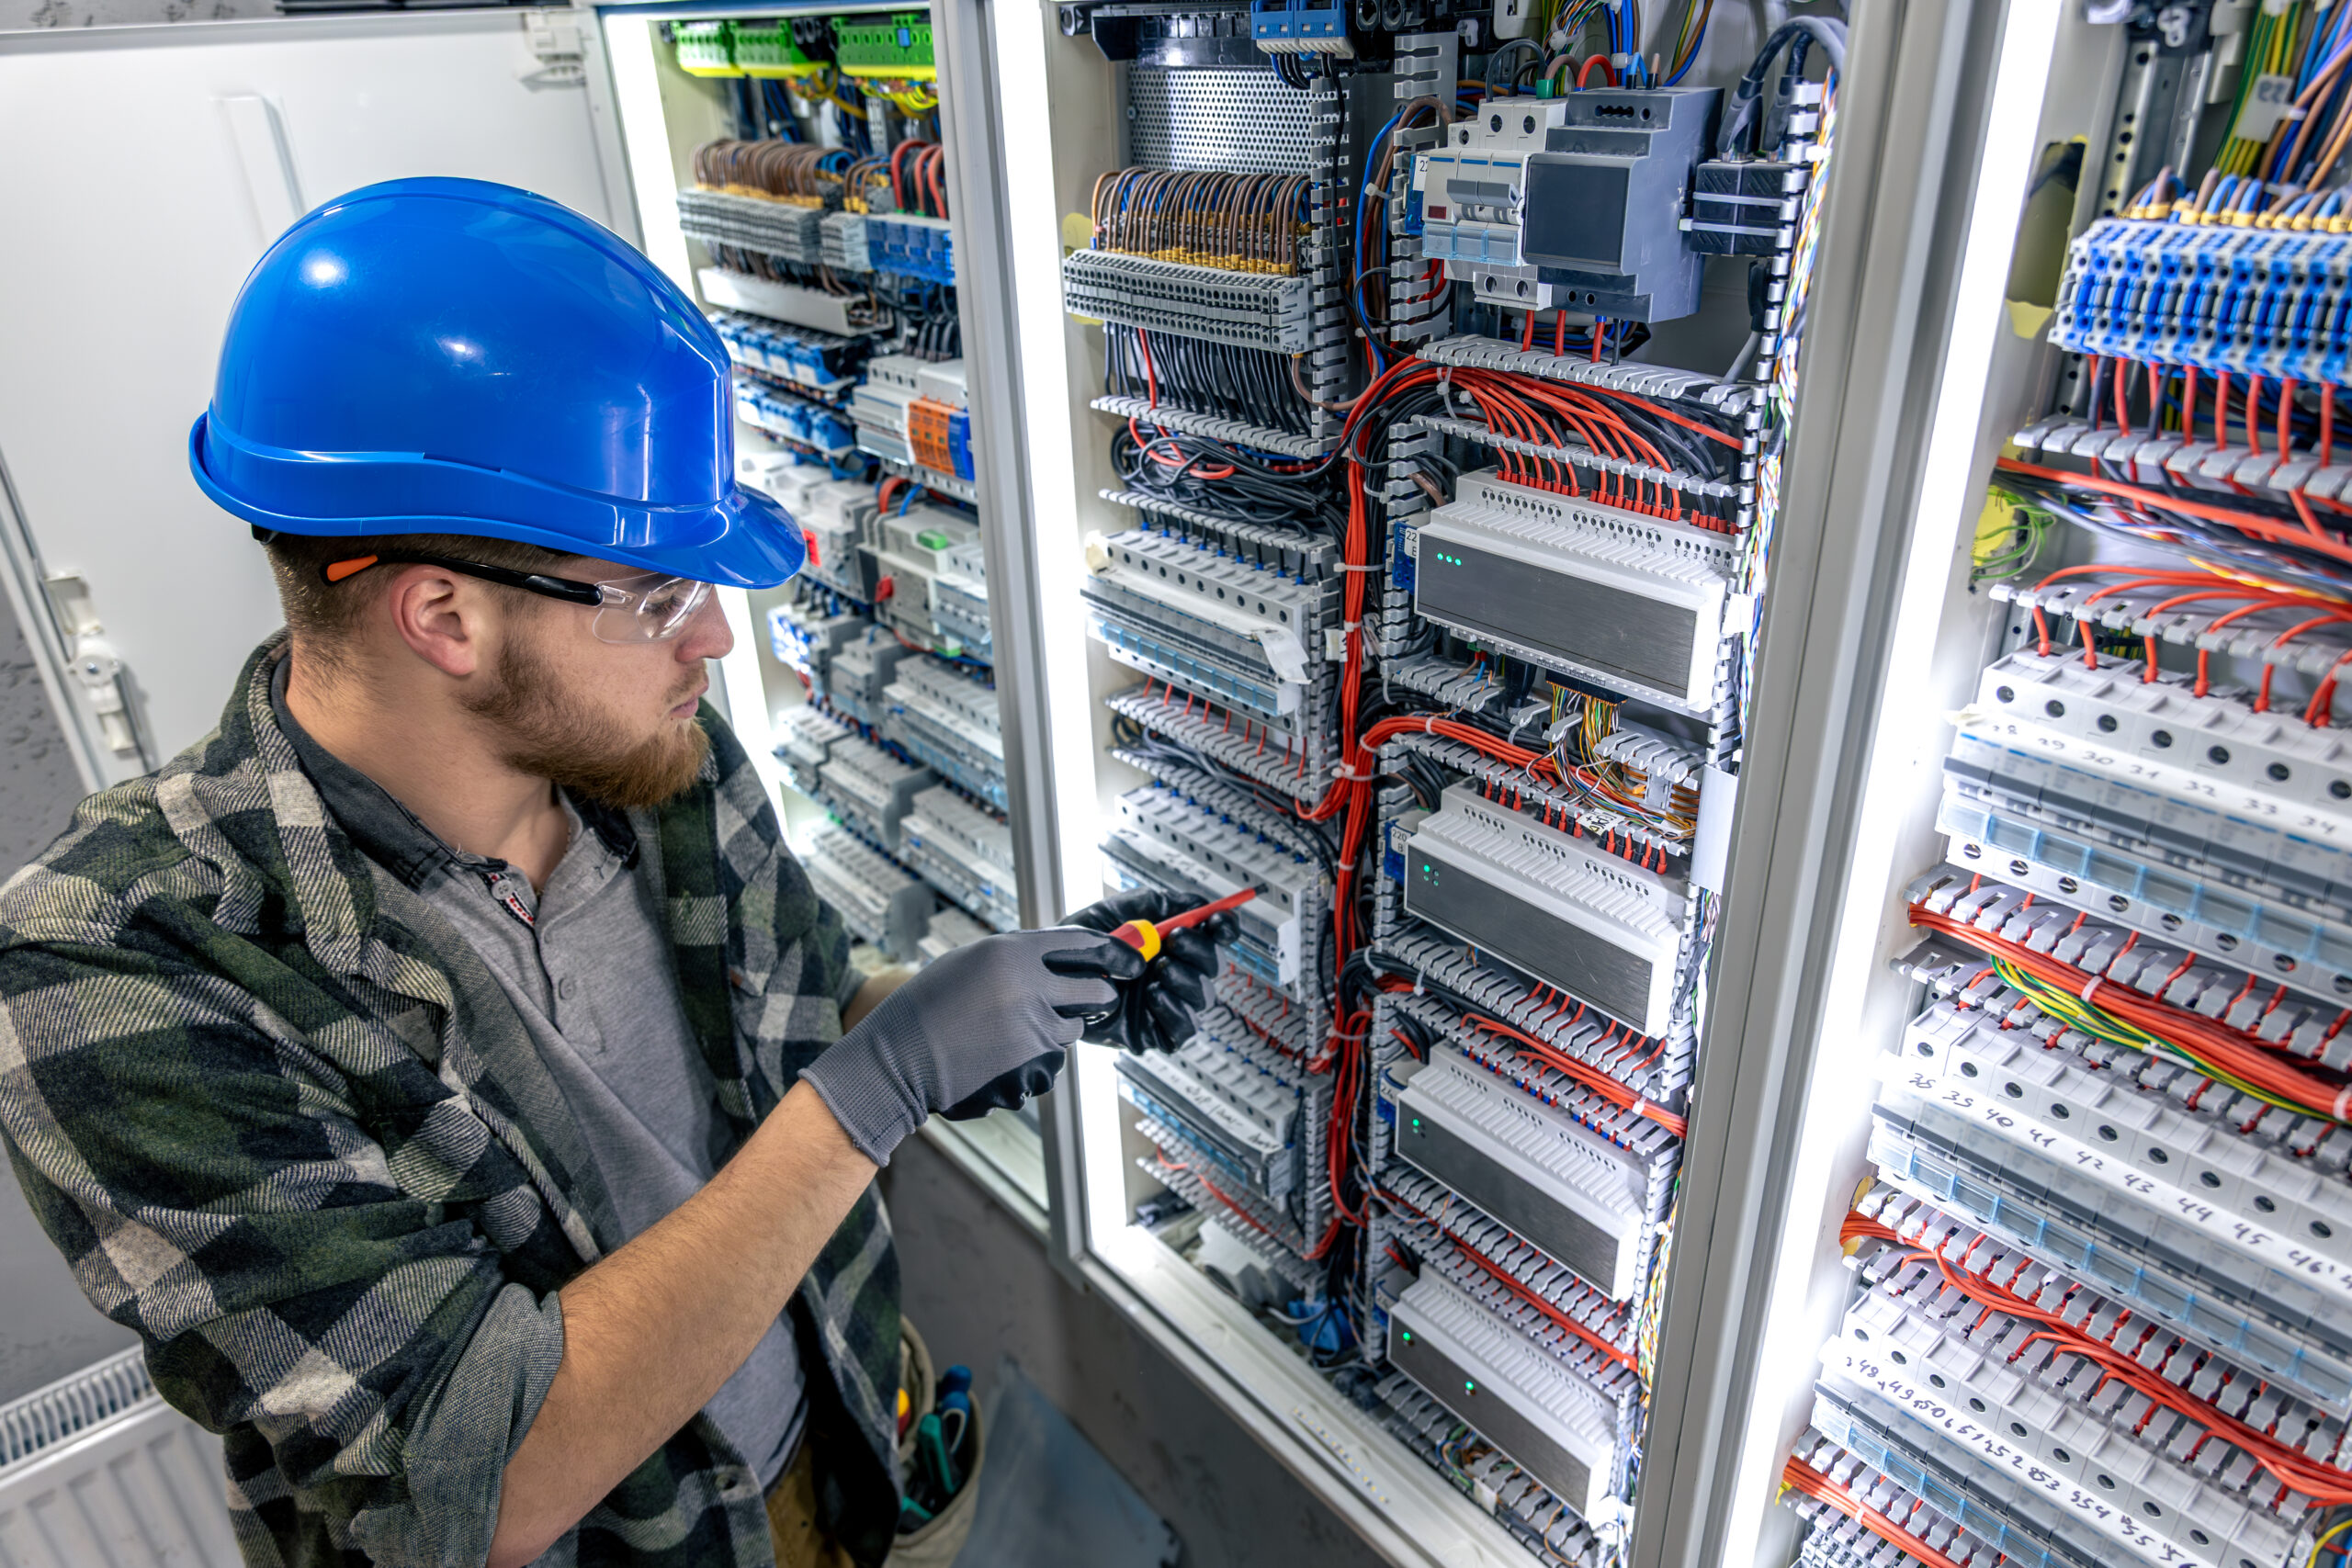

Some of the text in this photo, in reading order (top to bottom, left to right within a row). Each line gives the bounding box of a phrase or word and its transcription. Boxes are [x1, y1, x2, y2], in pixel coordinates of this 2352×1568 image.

[2038, 738, 2065, 750] 29
[2080, 750, 2115, 765] 30
[2183, 781, 2217, 797] 32
[2243, 797, 2278, 816] 33
[2298, 815, 2337, 835] 34
[1986, 1109, 2014, 1128] 40
[2030, 1128, 2056, 1147] 41
[2076, 1151, 2103, 1170] 42
[2124, 1174, 2154, 1193] 43
[2178, 1197, 2214, 1222] 44
[2233, 1223, 2274, 1246] 45
